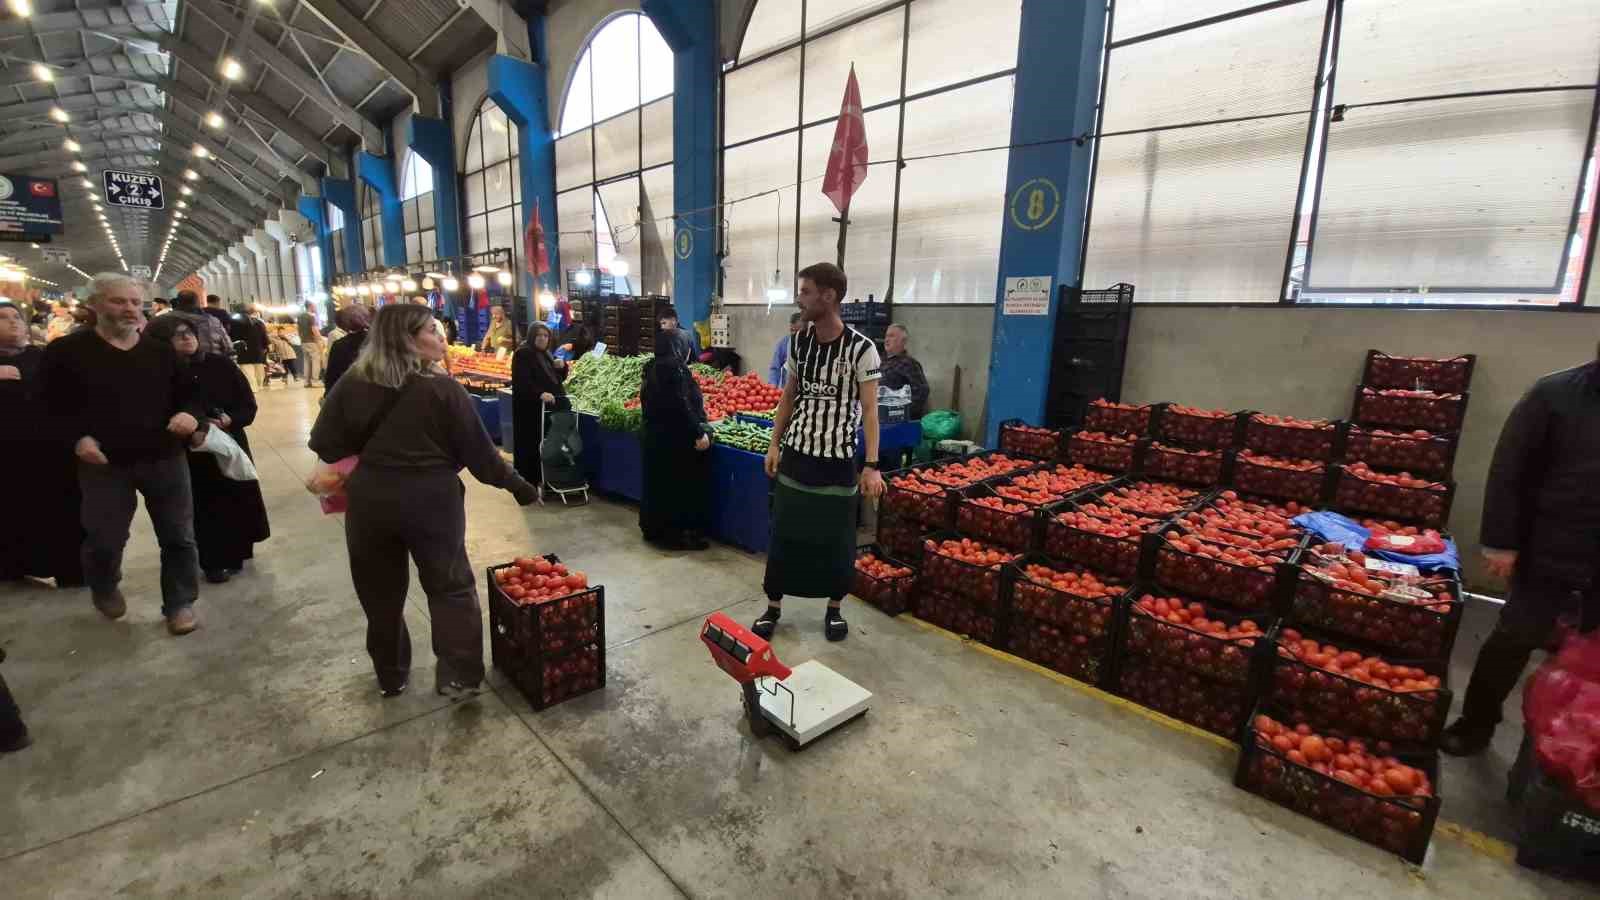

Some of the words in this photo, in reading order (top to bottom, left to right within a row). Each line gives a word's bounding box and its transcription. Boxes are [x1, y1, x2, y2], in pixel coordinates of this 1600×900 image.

[112, 172, 154, 185] KUZEY
[130, 184, 140, 196] 2
[119, 195, 152, 207] ÇIKIŞ
[1028, 190, 1044, 219] 8
[802, 377, 838, 396] beko
